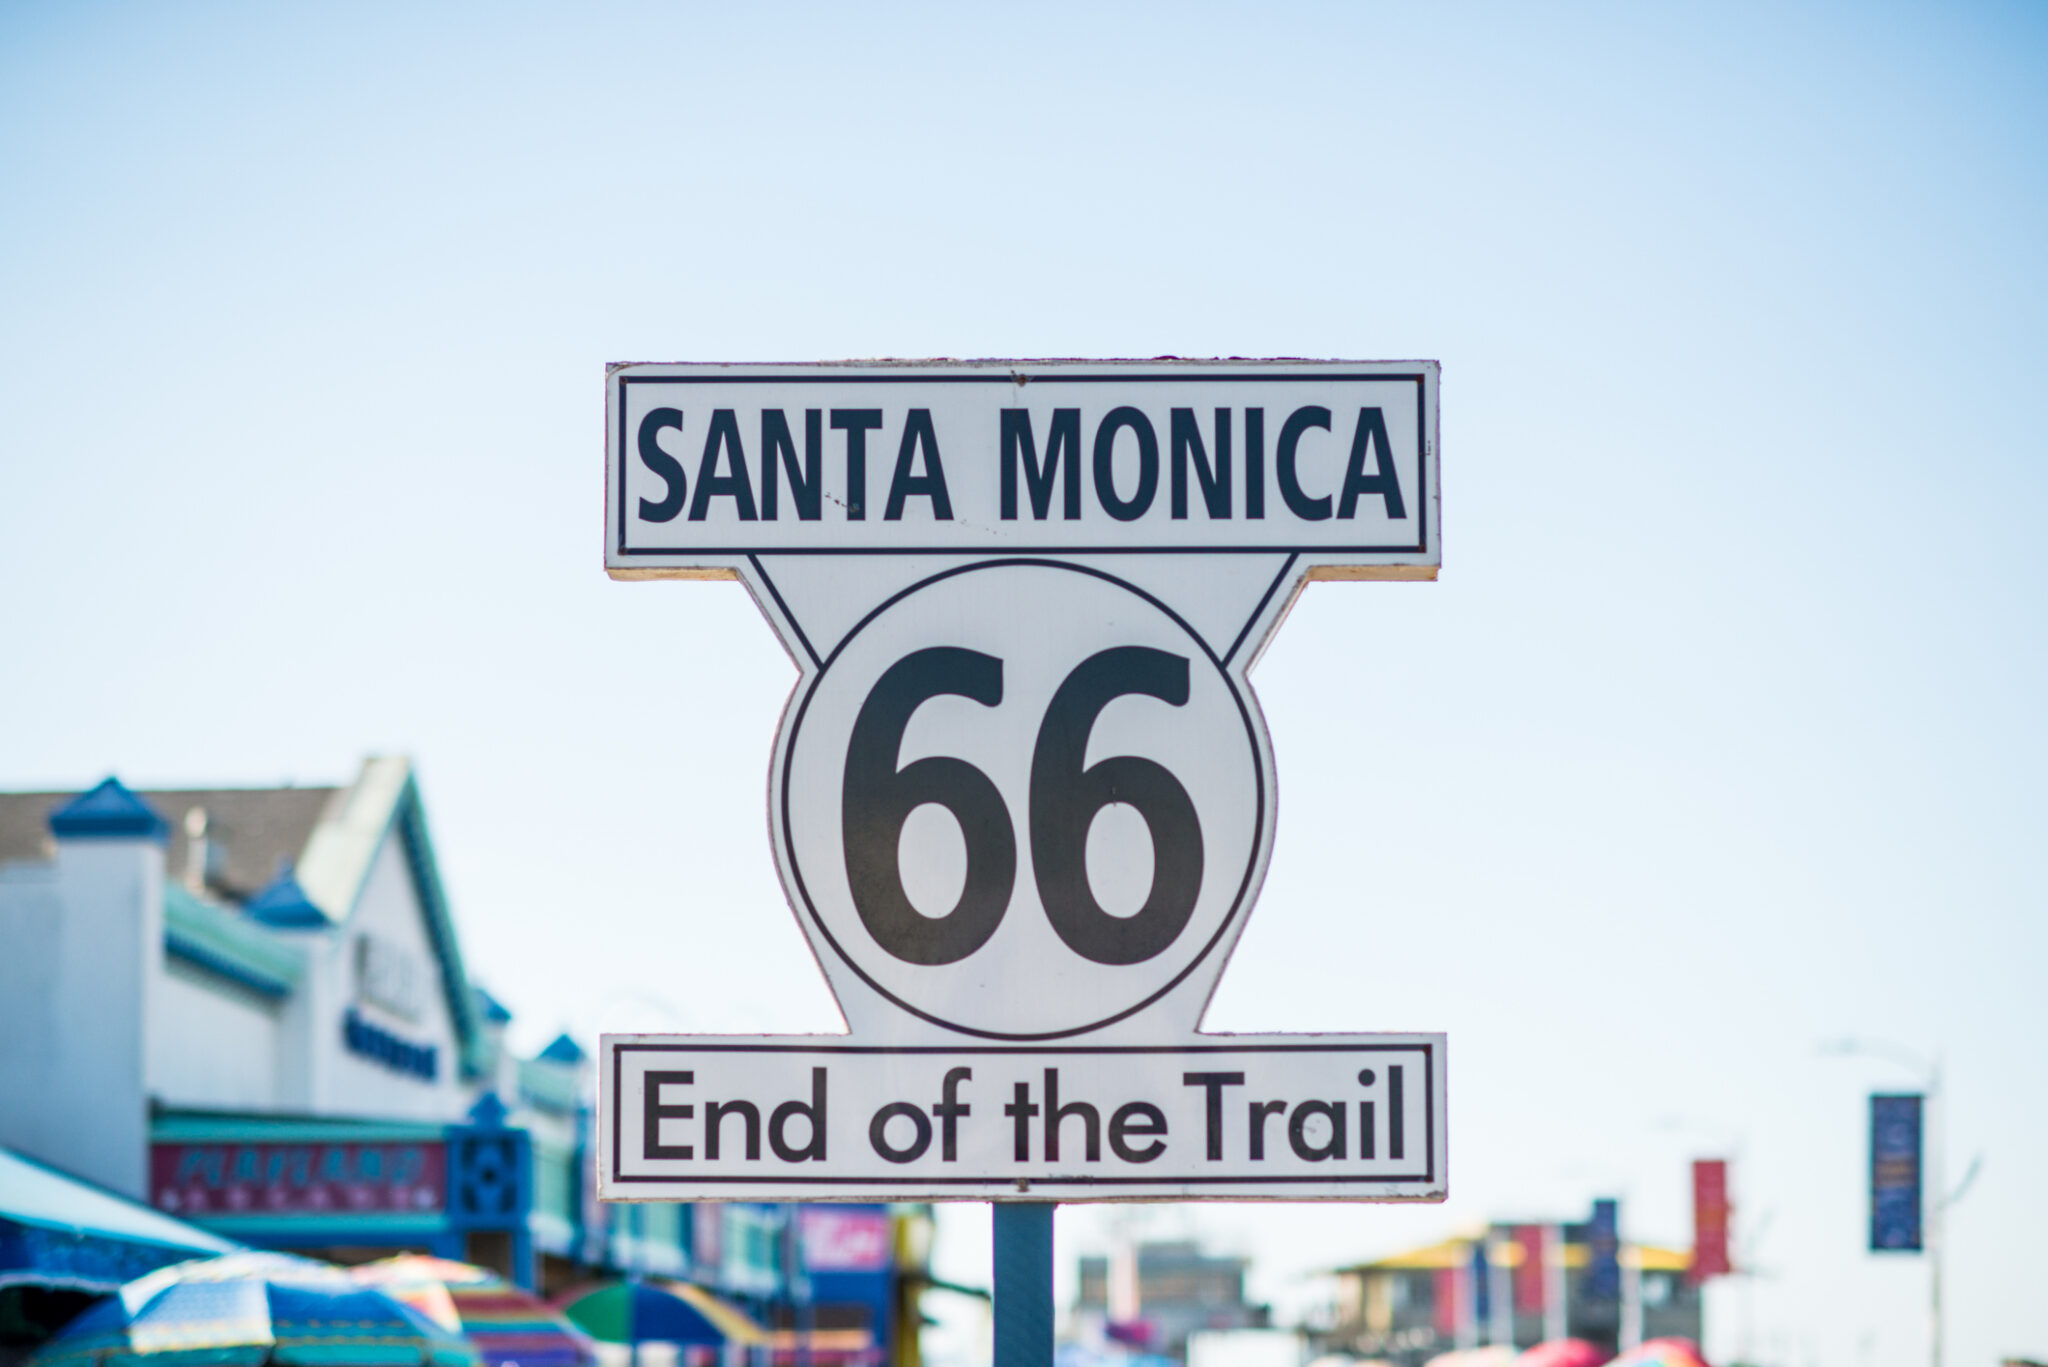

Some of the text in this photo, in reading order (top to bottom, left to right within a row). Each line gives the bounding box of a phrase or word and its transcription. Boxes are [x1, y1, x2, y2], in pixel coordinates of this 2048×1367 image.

[637, 405, 1407, 523] SANTA MONICA
[841, 645, 1204, 966] 66
[643, 1065, 1404, 1164] End of the Trail
